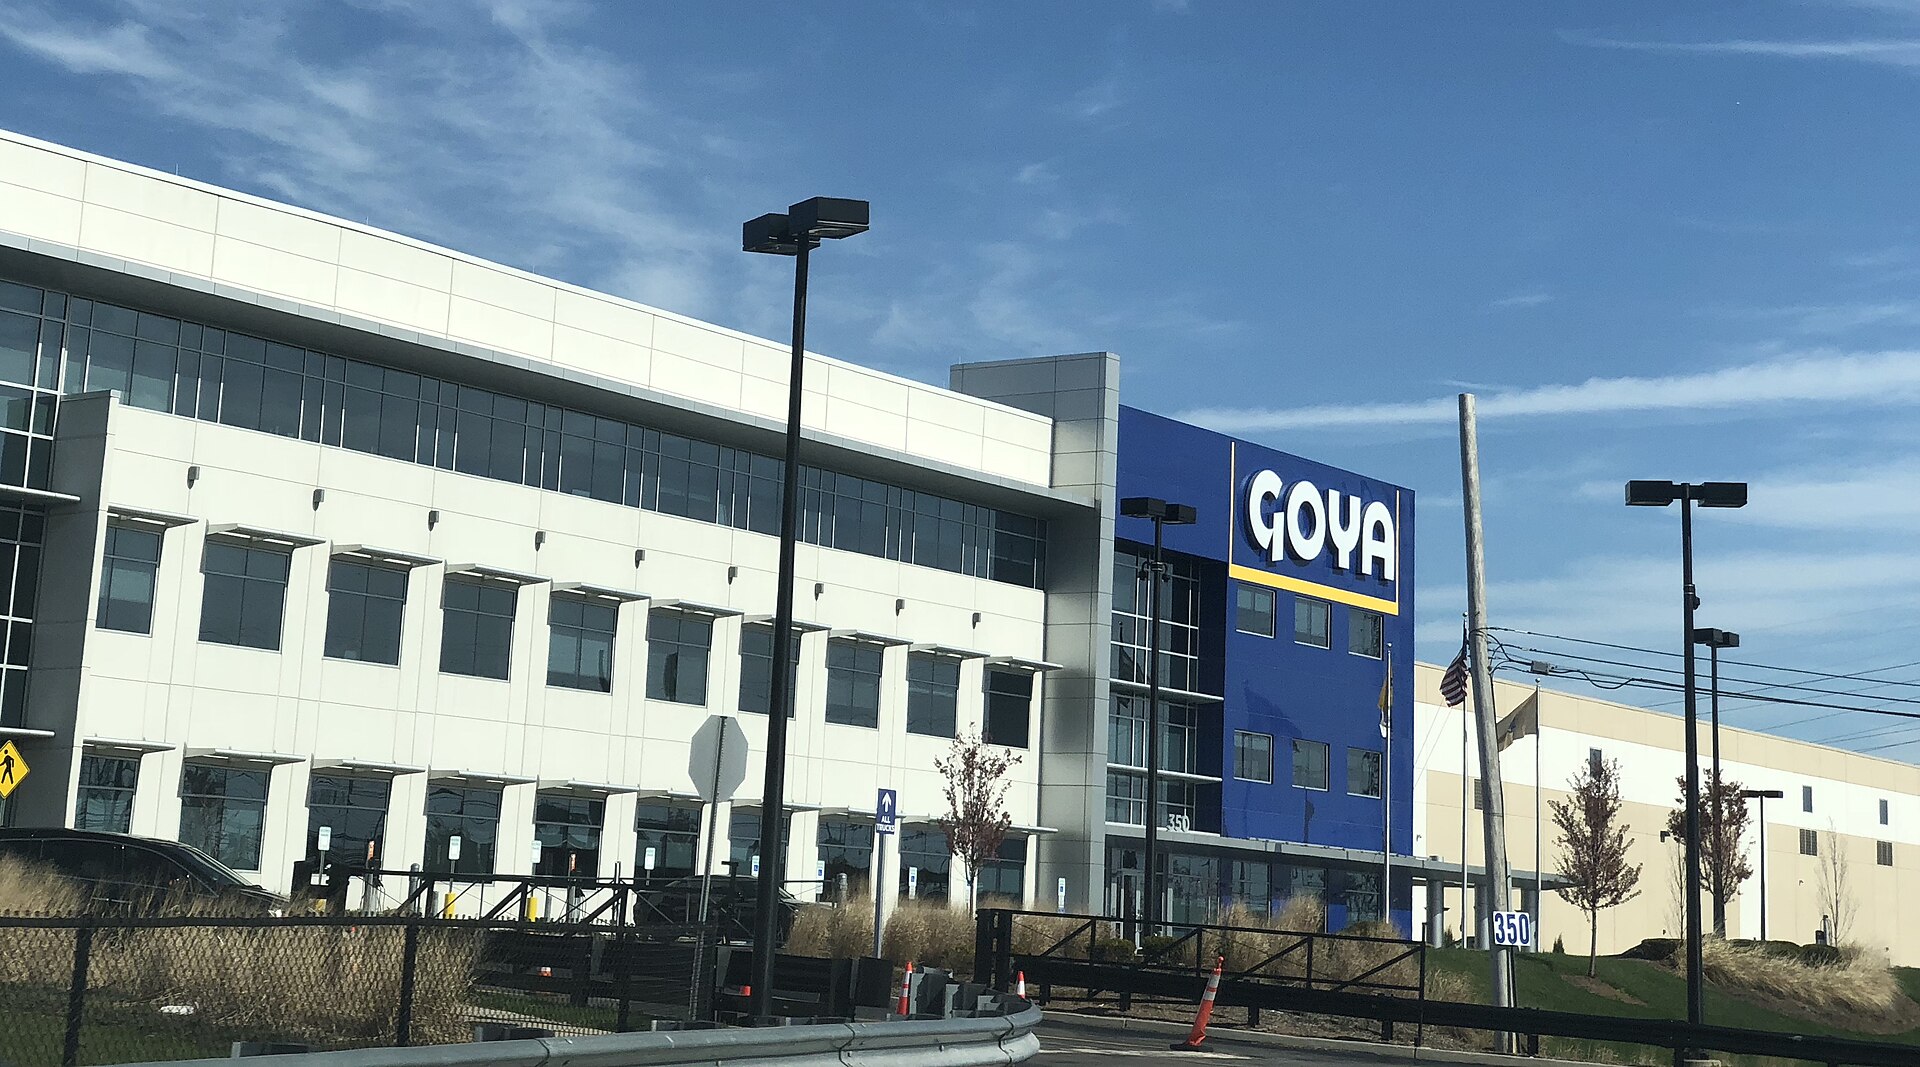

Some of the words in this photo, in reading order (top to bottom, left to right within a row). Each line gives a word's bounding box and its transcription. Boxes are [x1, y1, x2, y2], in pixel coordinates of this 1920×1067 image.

[1247, 469, 1395, 581] GOYA
[876, 823, 895, 833] TRUCKS
[881, 815, 891, 824] ALL
[1166, 813, 1190, 833] 350
[1494, 912, 1530, 945] 350
